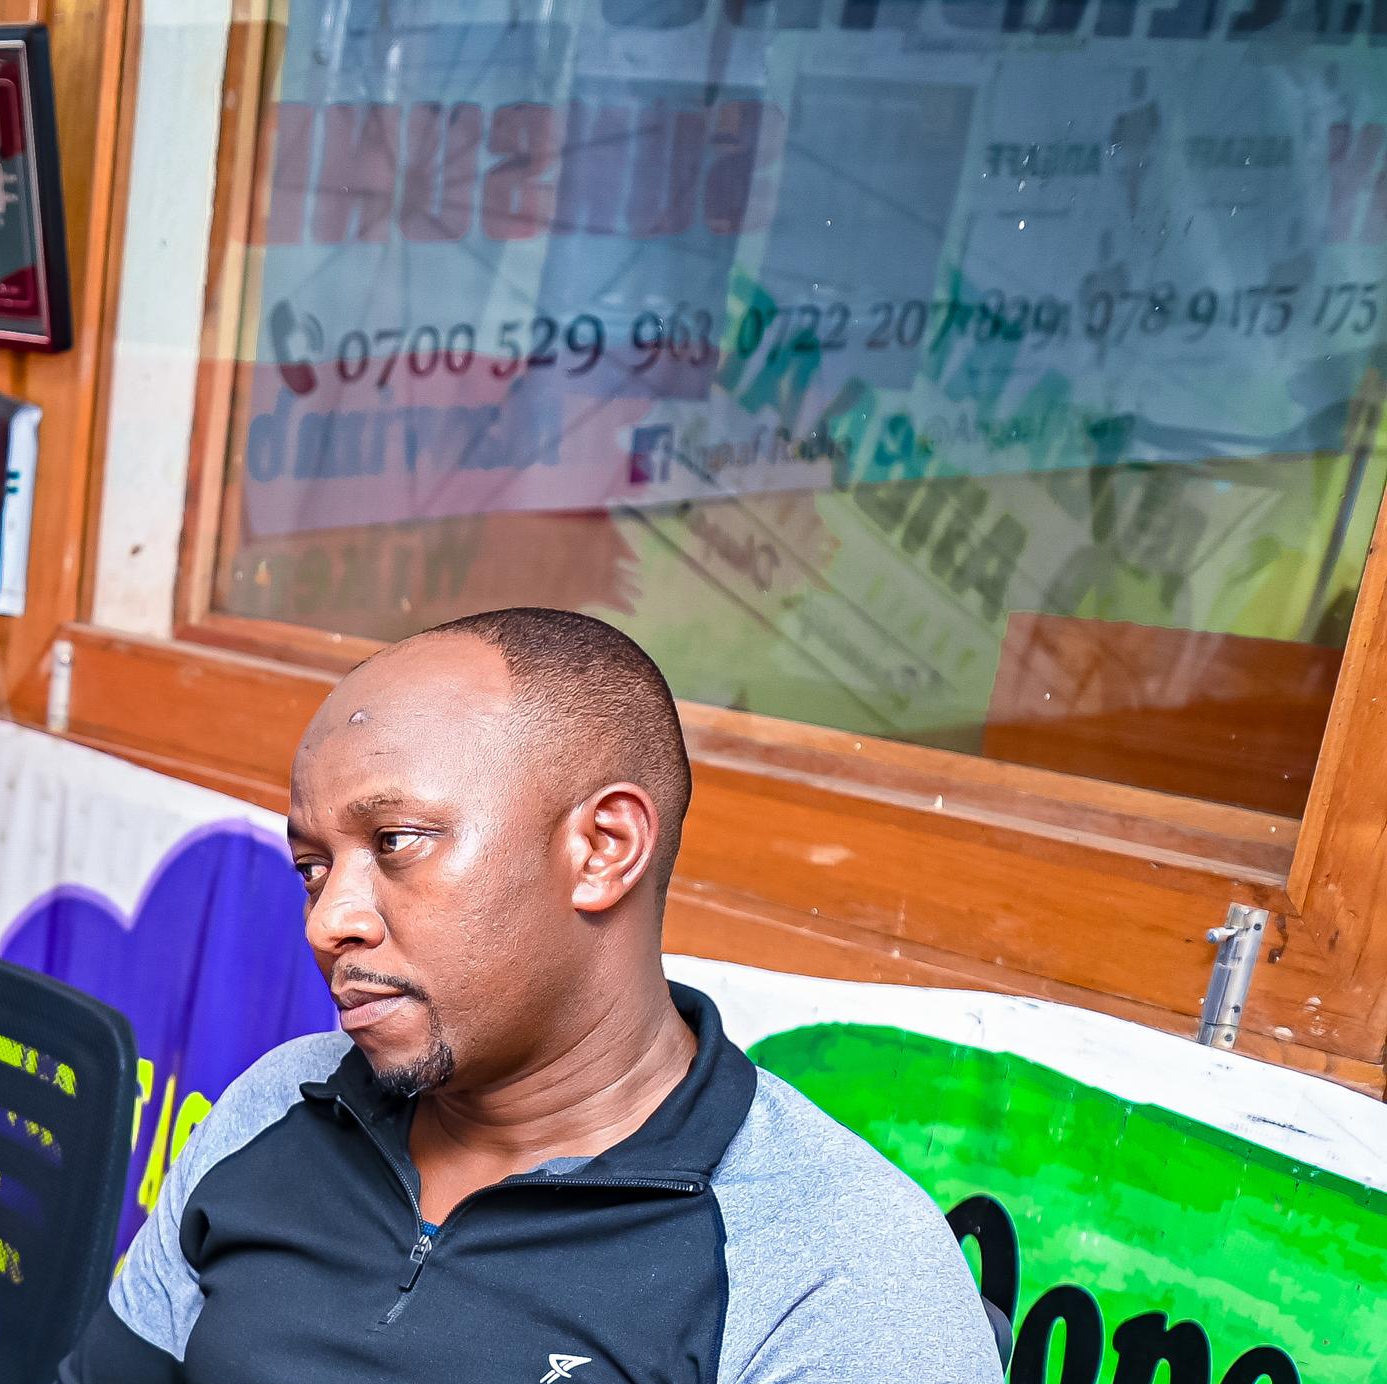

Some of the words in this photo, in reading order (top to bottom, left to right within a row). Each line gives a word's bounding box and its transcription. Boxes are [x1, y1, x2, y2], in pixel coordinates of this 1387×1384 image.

[334, 322, 478, 390] 0700
[491, 312, 607, 380] 529
[630, 301, 714, 374] 963
